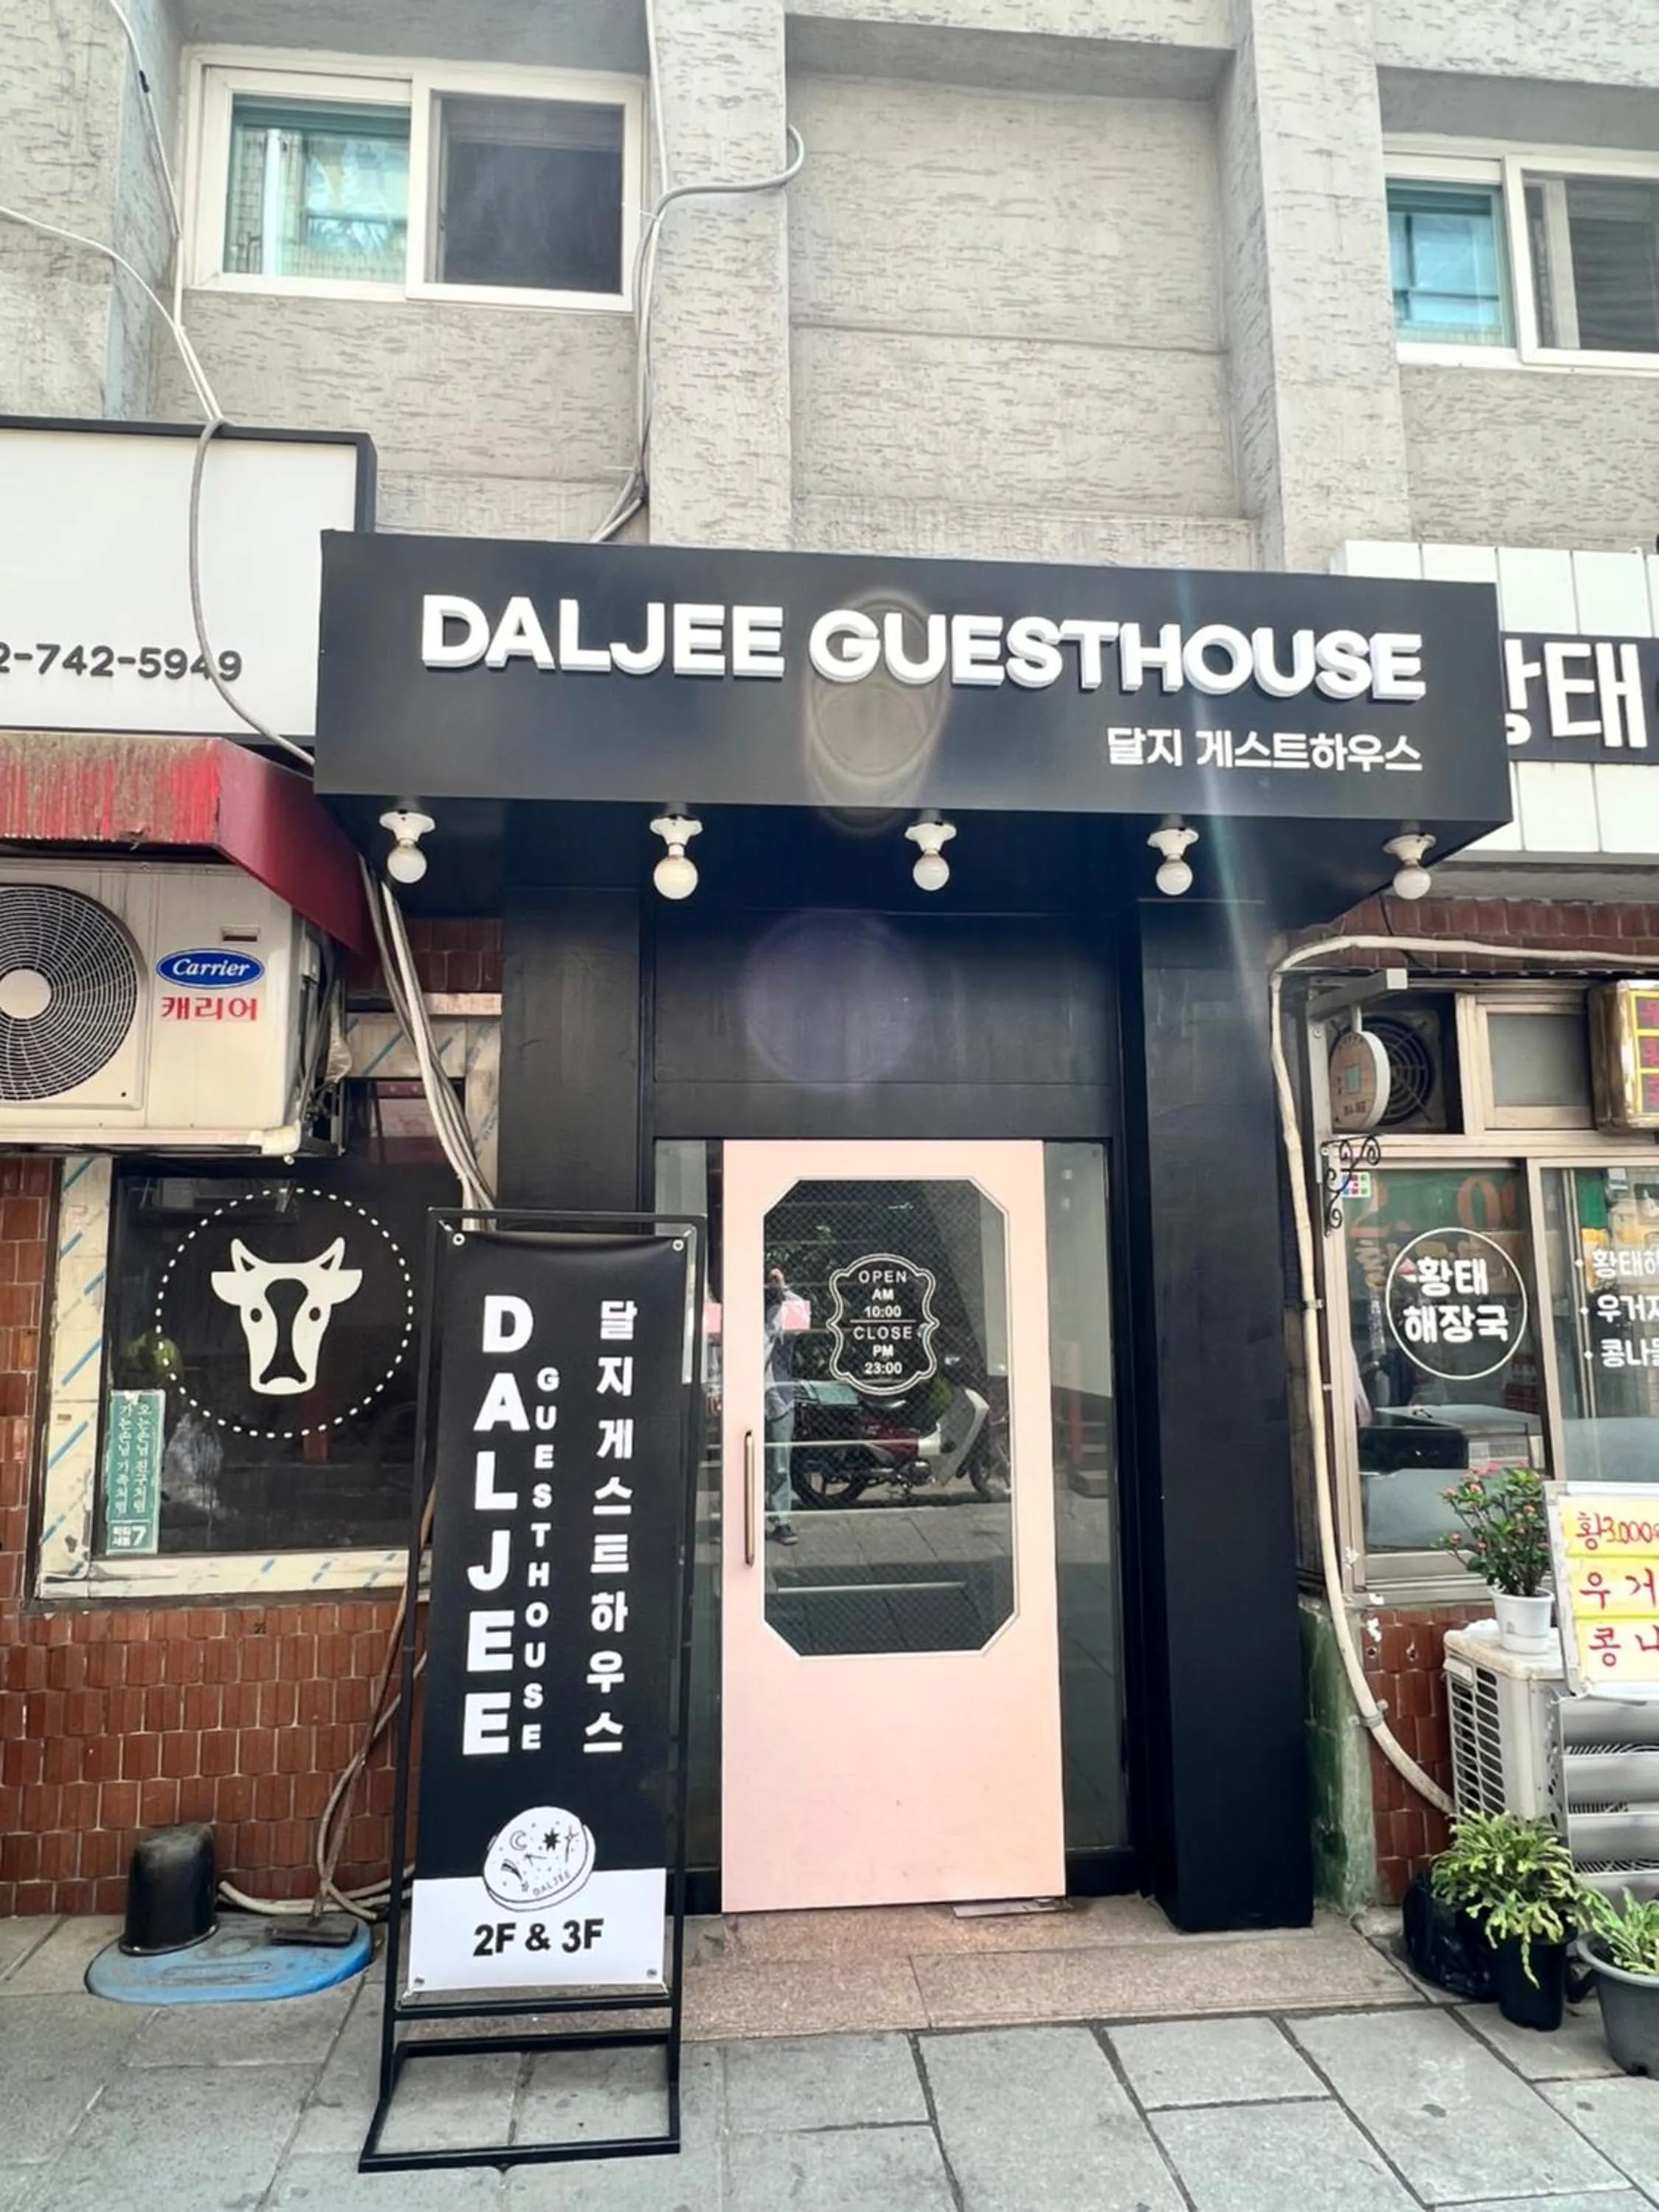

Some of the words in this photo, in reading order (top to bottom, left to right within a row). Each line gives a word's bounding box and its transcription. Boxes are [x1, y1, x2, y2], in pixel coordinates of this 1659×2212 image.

[422, 594, 785, 678] DALJEE
[808, 609, 1427, 702] GUESTHOUSE
[1107, 727, 1183, 768] 달지
[1197, 730, 1423, 772] 게스트하우스
[173, 958, 251, 977] Carrier
[161, 997, 257, 1020] 캐리어
[858, 1270, 908, 1284] OPEN
[1416, 1256, 1489, 1296] 황태
[872, 1288, 894, 1301] AM
[863, 1305, 902, 1318] 10:00
[1402, 1304, 1509, 1343] 해장국
[852, 1326, 913, 1340] CLOSE
[872, 1344, 894, 1357] PM
[864, 1362, 903, 1374] 23:00
[462, 1295, 535, 1756] DALJEE
[583, 1300, 638, 1753] 달지게스트하우스
[521, 1366, 560, 1750] GUESTHOUSE
[473, 1922, 516, 1957] 2F
[524, 1922, 552, 1952] &
[561, 1917, 605, 1953] 3F
